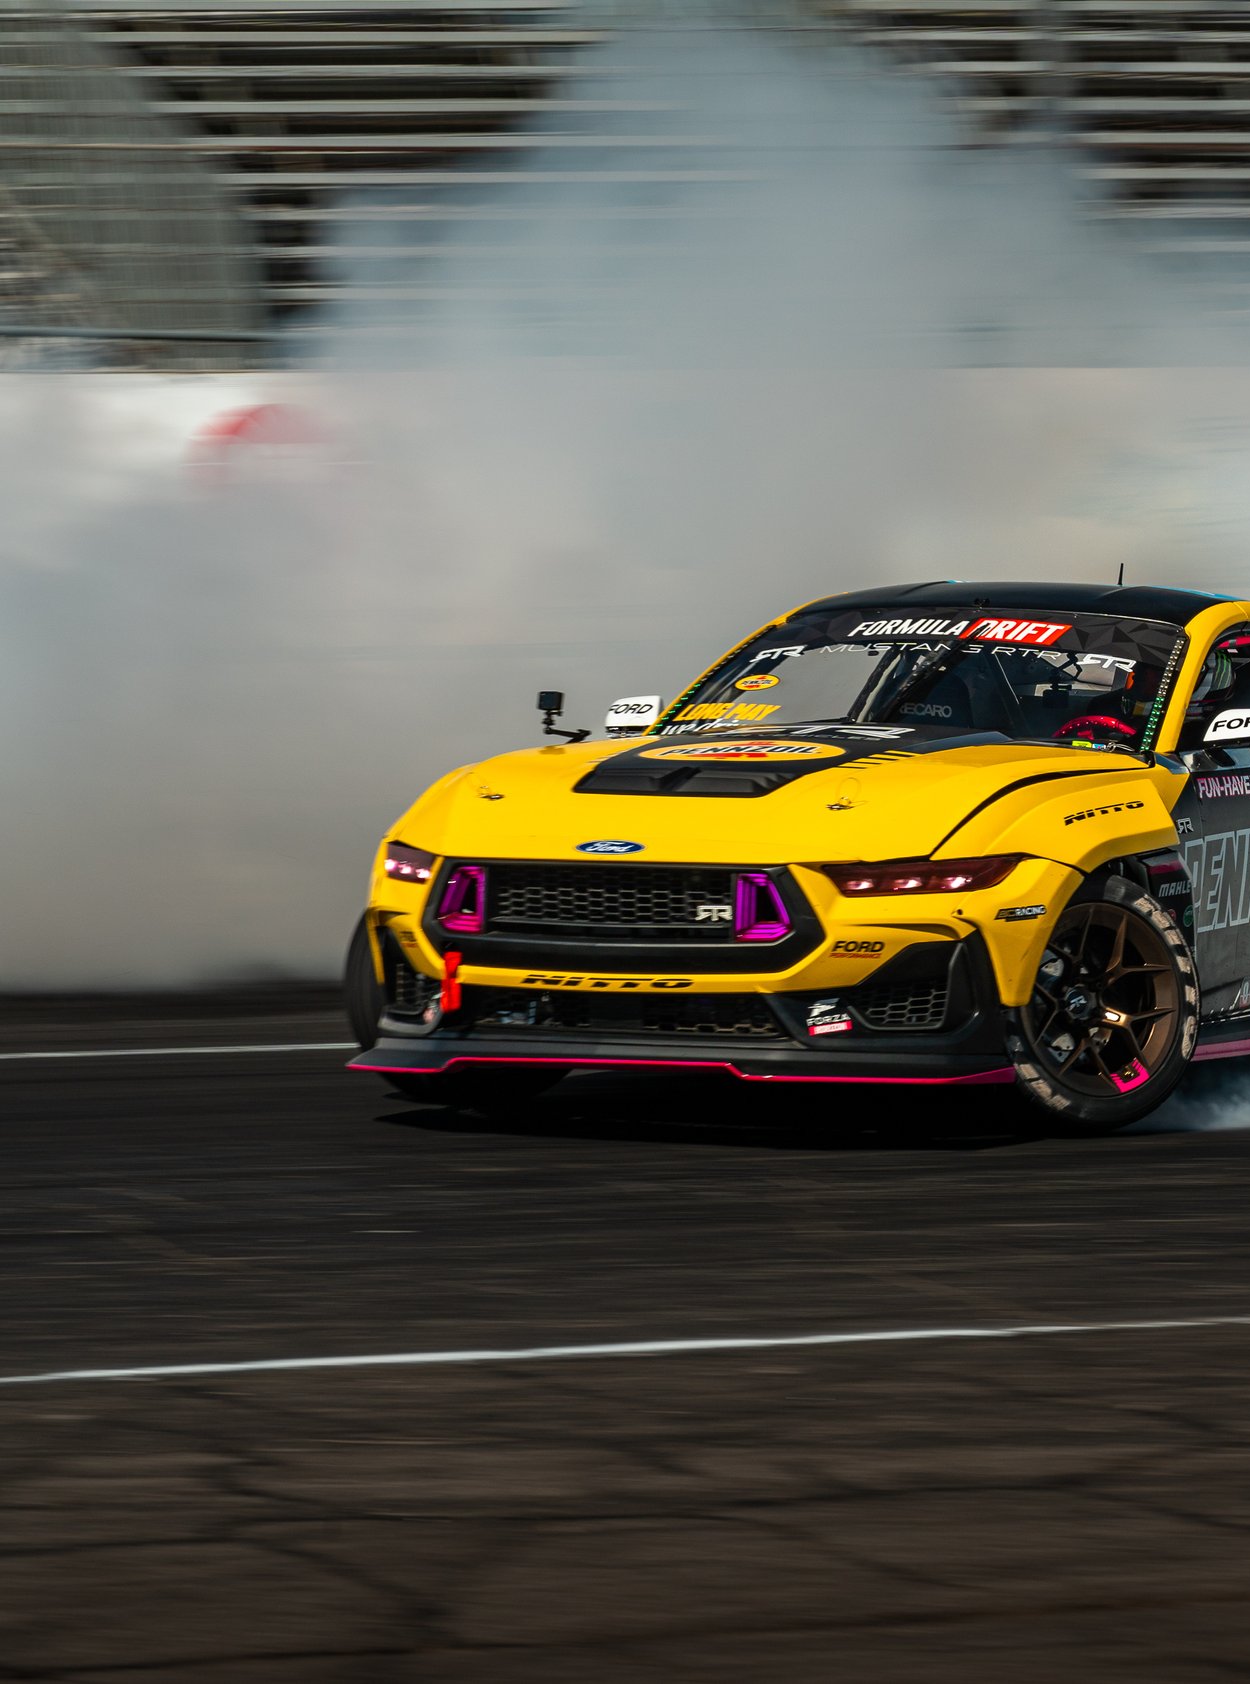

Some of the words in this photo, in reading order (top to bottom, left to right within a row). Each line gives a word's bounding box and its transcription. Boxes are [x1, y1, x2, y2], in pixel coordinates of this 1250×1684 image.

[847, 619, 970, 637] FORMULA
[966, 620, 1065, 642] DRIFT
[818, 642, 984, 654] MUSTANG
[991, 646, 1061, 660] RTR
[608, 703, 653, 714] FORD
[673, 703, 735, 721] LONG
[725, 703, 781, 721] MAY
[656, 745, 817, 757] PENNZOIL
[1064, 800, 1144, 826] NITTO
[585, 841, 635, 853] Ford
[1159, 880, 1193, 897] MAHLE
[694, 905, 733, 921] RTR
[832, 941, 885, 952] FORD
[520, 974, 694, 988] NITTO
[806, 1013, 851, 1026] FORZA
